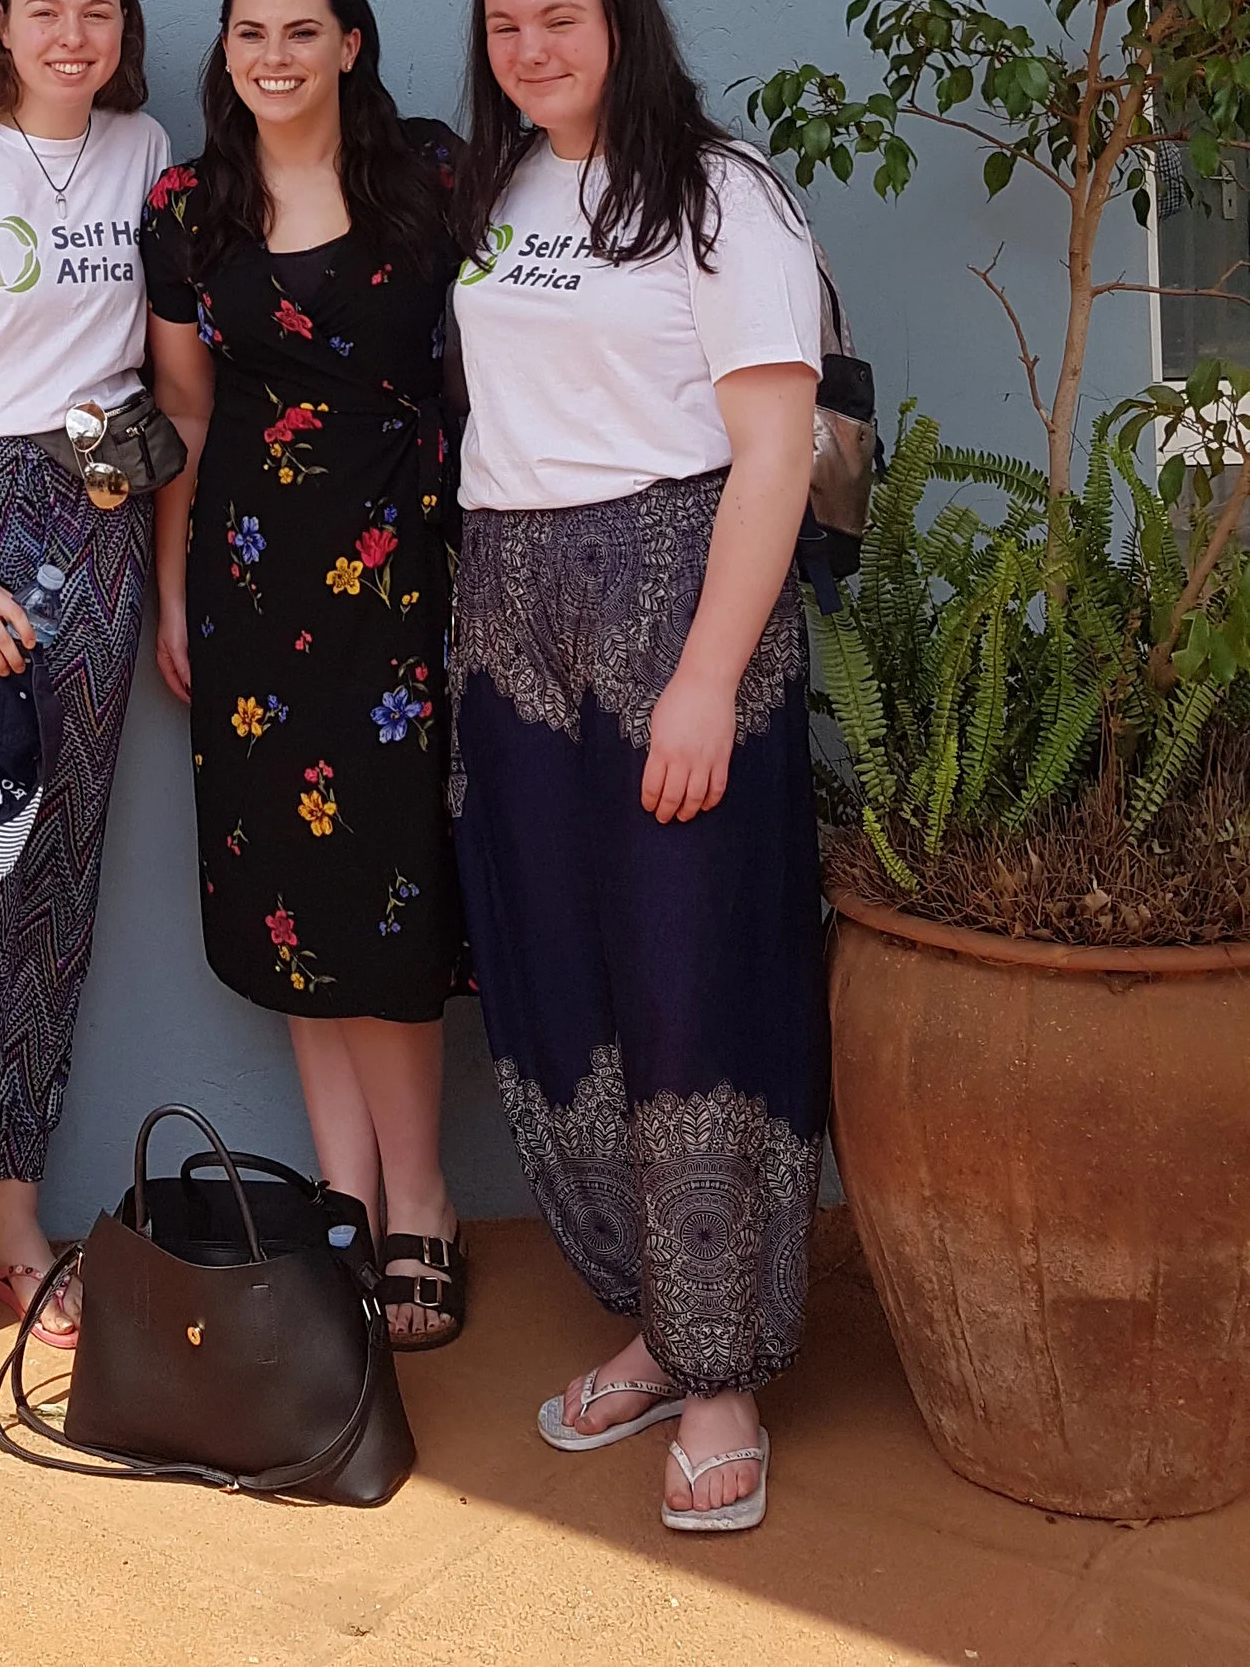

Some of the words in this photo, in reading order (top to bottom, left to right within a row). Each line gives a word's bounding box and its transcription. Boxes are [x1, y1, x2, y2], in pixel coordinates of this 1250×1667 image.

[52, 221, 104, 250] Self
[518, 234, 572, 259] Self
[57, 257, 134, 285] Africa
[499, 264, 581, 290] Africa
